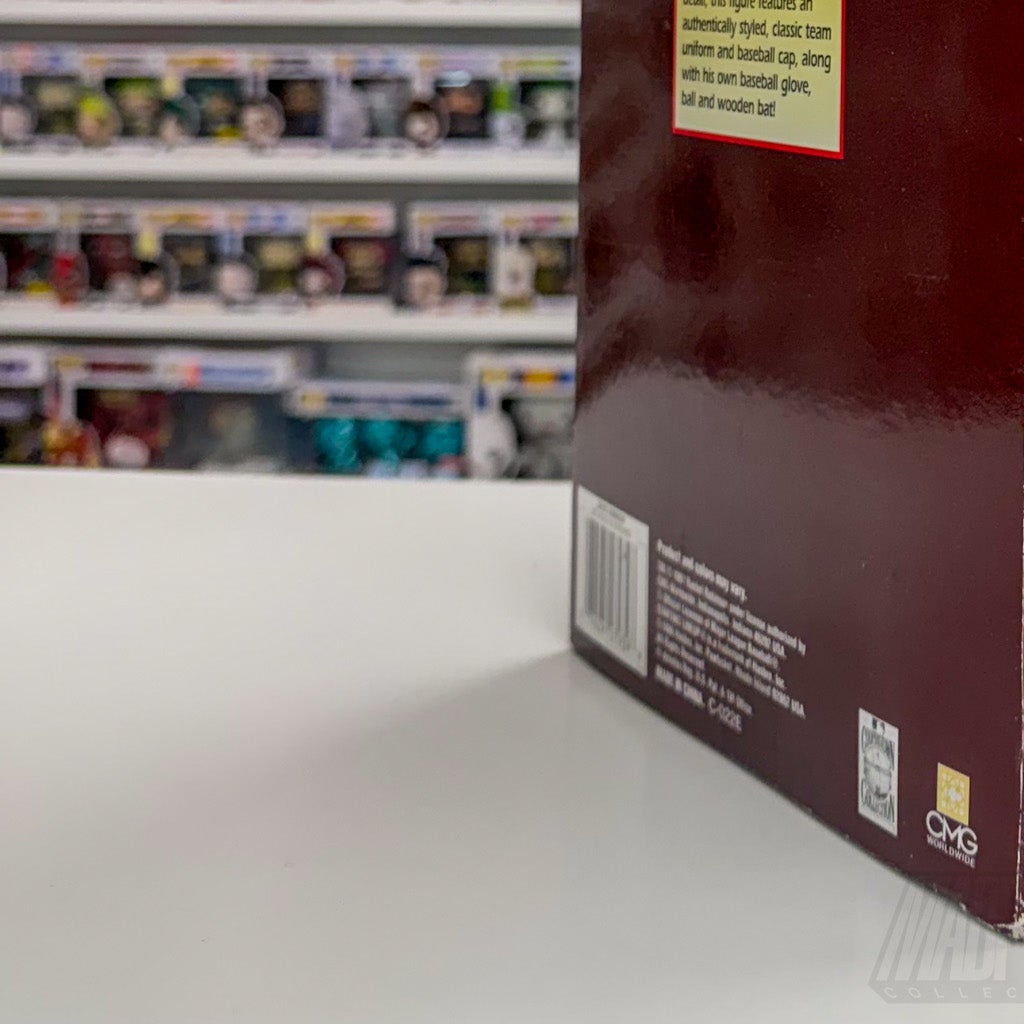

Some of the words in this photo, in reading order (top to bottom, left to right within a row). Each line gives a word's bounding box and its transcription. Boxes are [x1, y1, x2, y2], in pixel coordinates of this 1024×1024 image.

[682, 16, 737, 38] authentically
[739, 20, 769, 40] styled,
[772, 20, 803, 39] classic
[805, 24, 832, 41] team
[682, 40, 715, 57] uniform
[717, 44, 735, 60] and
[737, 44, 775, 64] baseball
[778, 50, 799, 71] cap,
[801, 50, 832, 74] along
[681, 65, 701, 82] with
[702, 67, 715, 85] his
[717, 72, 738, 86] own
[740, 69, 778, 91] baseball
[781, 76, 812, 97] glove,
[681, 90, 696, 106] ball
[698, 92, 715, 110] and
[717, 95, 755, 115] wooden
[757, 99, 776, 117] bat!
[926, 809, 978, 856] CMG
[926, 833, 976, 869] WORLDWIDE
